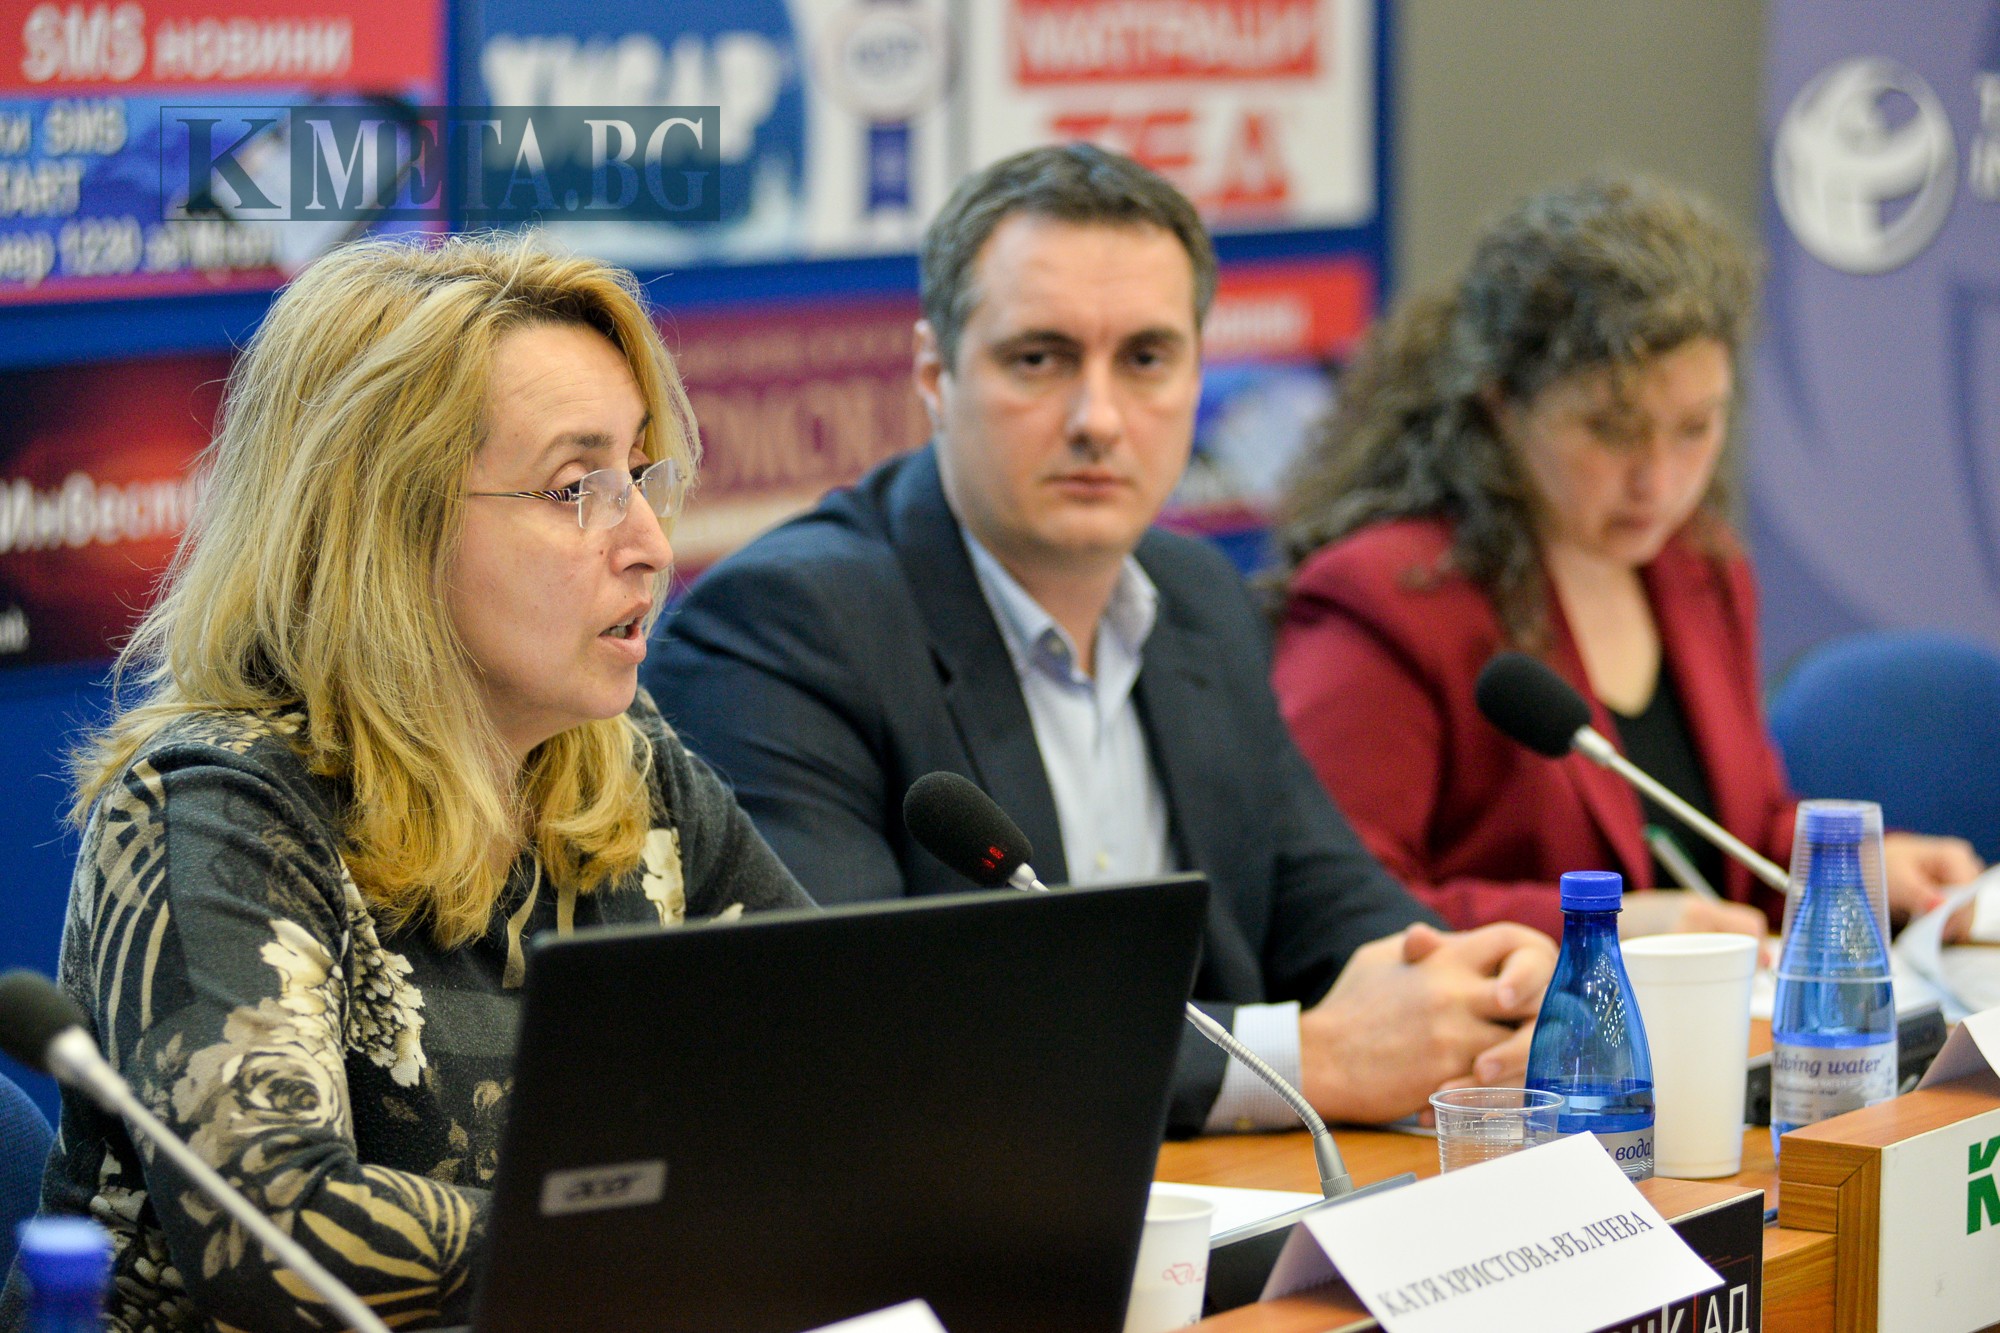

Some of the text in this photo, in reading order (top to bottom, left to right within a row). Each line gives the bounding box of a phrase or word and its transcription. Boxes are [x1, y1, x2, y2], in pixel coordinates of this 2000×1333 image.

[20, 4, 146, 82] SMS
[1774, 1052, 1881, 1077] Living water
[1615, 1137, 1652, 1161] вода
[1376, 1210, 1655, 1318] КАТЯ ХРИСТОВА-ВЪЛЧЕВА
[1703, 1284, 1749, 1333] АД
